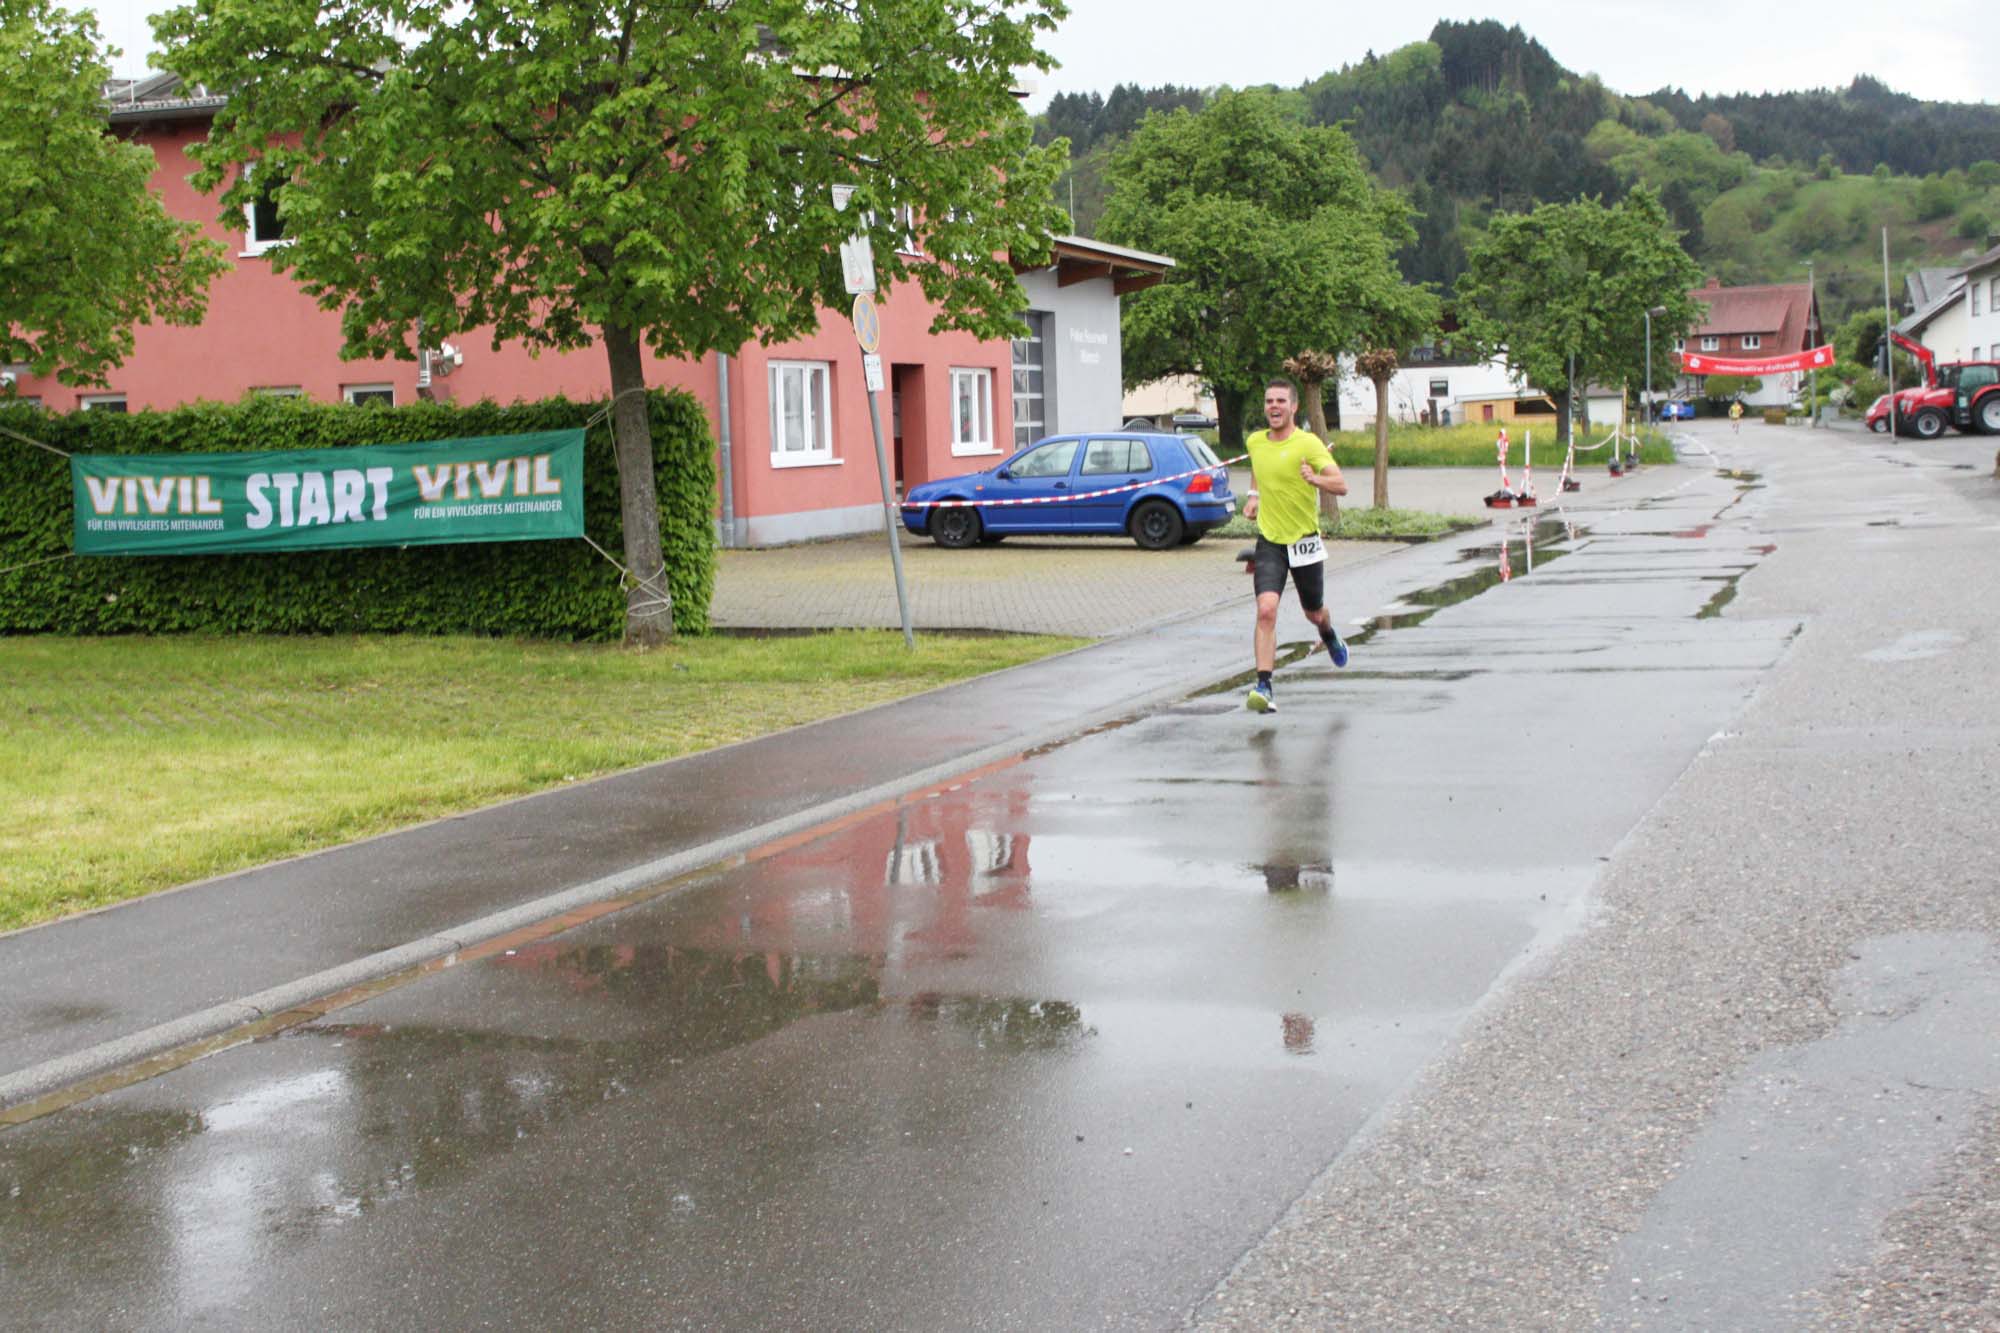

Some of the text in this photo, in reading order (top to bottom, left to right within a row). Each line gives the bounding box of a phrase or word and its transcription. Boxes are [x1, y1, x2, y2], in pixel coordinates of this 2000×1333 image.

[84, 455, 561, 529] VIVIL START VIVIL
[414, 506, 430, 519] FÜR
[432, 507, 446, 518] EIN
[504, 500, 562, 514] MITEINANDER
[88, 518, 103, 531] FÜR
[104, 519, 117, 531] EIN
[170, 519, 224, 531] MITEINANDER
